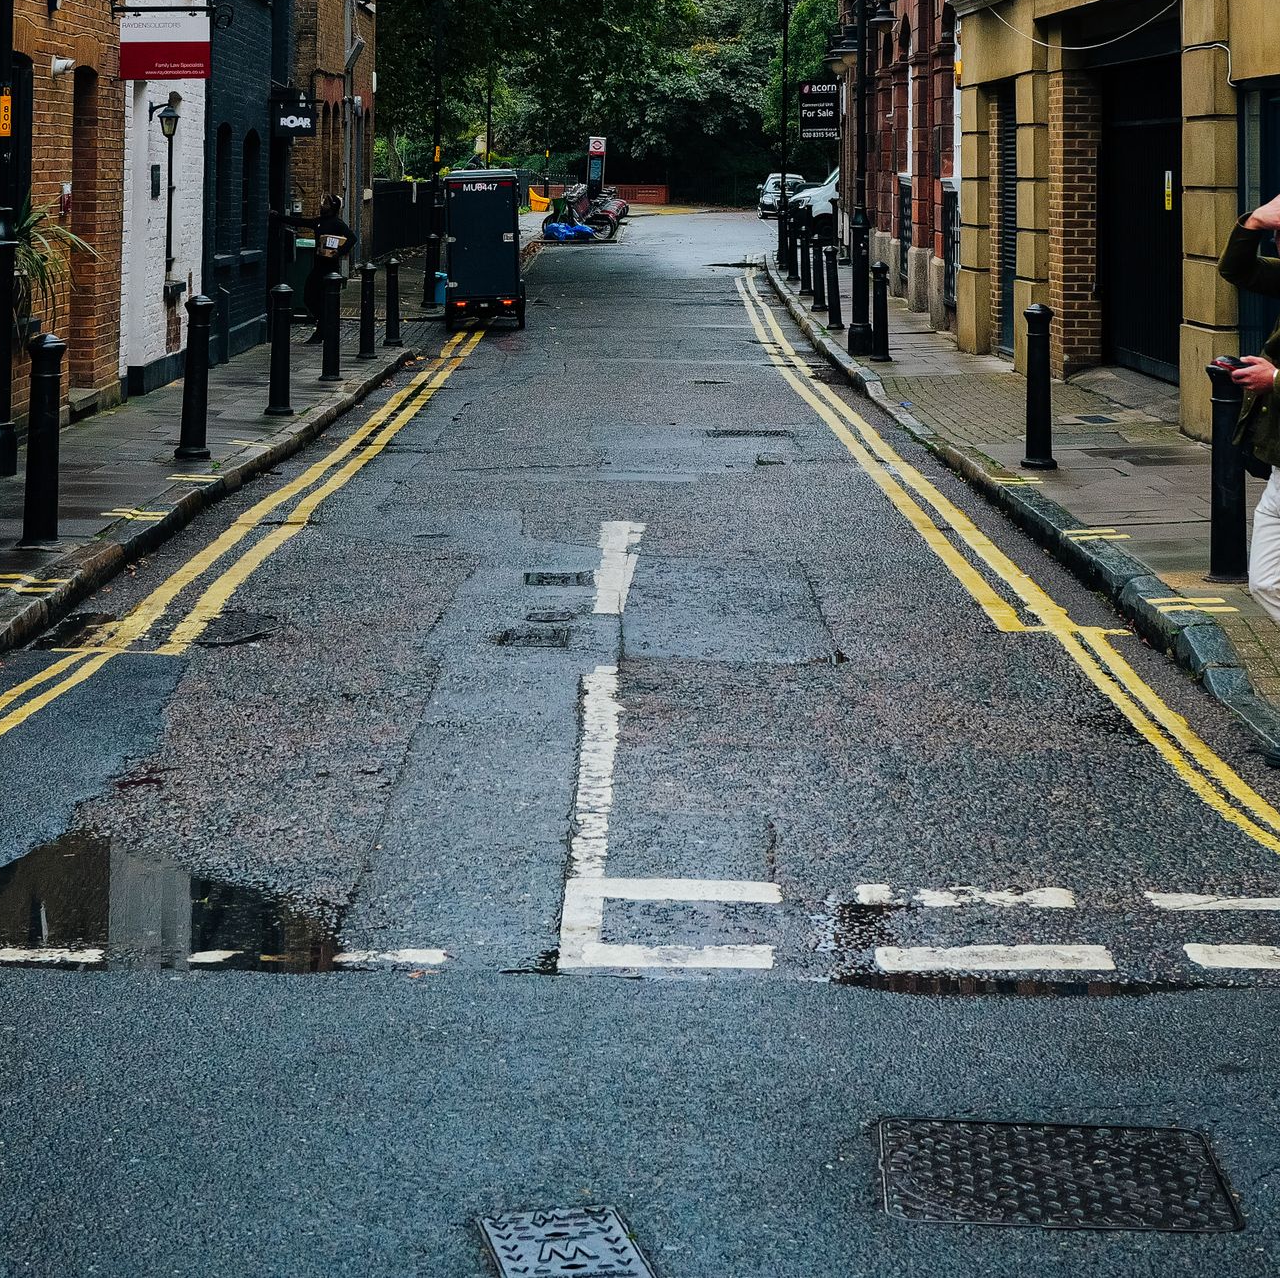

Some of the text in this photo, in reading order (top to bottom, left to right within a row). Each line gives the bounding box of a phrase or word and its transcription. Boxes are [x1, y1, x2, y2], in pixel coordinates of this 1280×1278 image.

[811, 84, 837, 92] acorn
[802, 109, 834, 118] For Sale
[280, 115, 311, 128] ROAR
